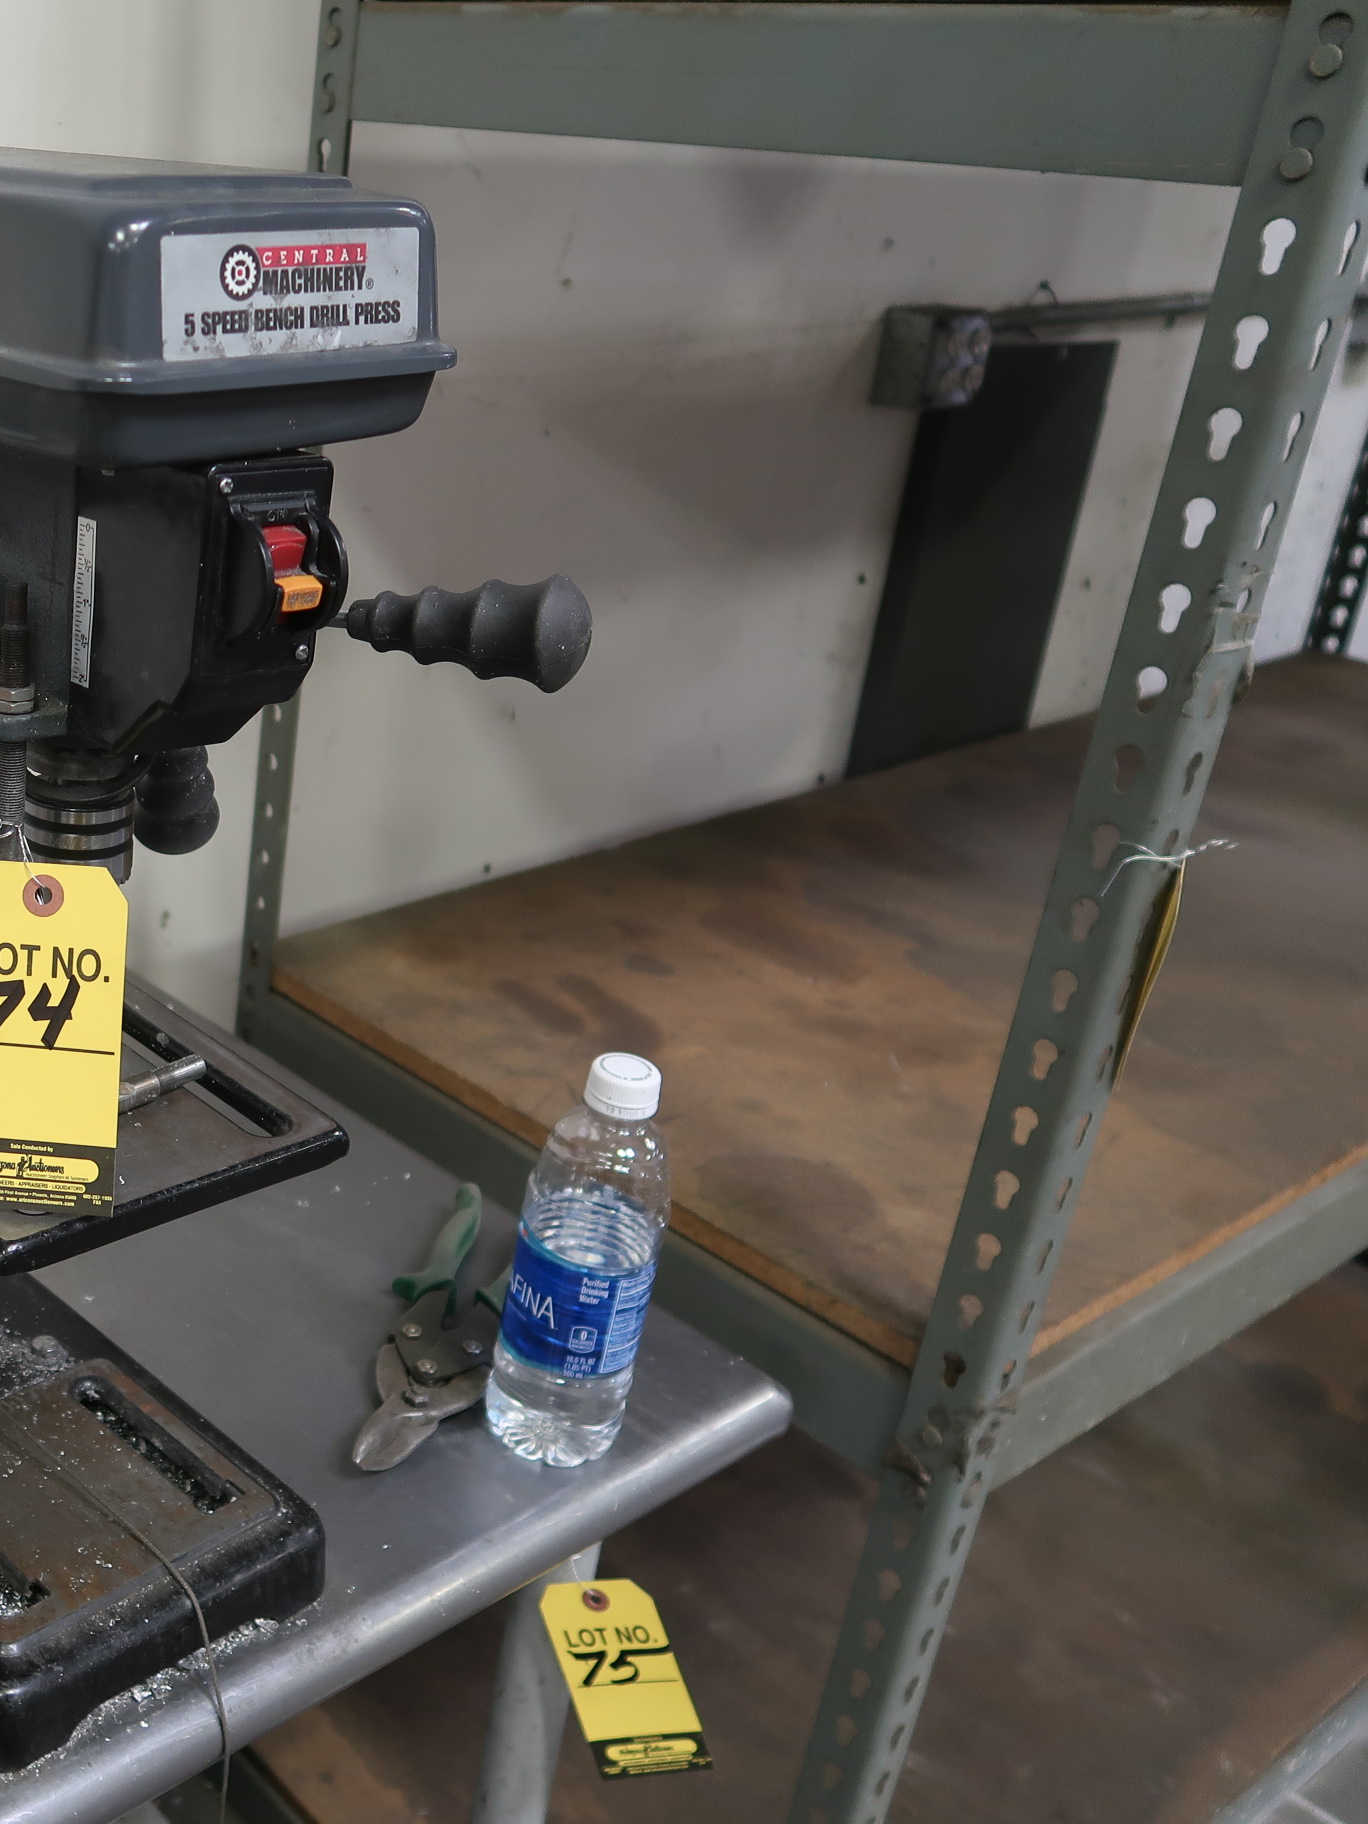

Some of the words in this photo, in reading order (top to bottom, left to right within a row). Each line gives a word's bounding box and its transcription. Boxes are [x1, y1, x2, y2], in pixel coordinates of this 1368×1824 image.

[262, 247, 364, 266] CENTRAL
[184, 313, 196, 337] 5
[200, 309, 250, 336] SPEED
[254, 305, 305, 332] BENCH
[309, 302, 350, 328] DRILL
[354, 300, 401, 325] PRESS
[51, 946, 109, 983] NO.
[22, 1144, 47, 1152] Conducted
[23, 1154, 65, 1175] Auctioneers
[18, 1181, 49, 1189] APPRAISERS
[52, 1184, 84, 1192] LIQUIDATORS
[582, 1277, 610, 1289] Purified
[579, 1295, 600, 1305] Water
[581, 1286, 610, 1299] Drinking
[580, 1331, 588, 1341] 0
[563, 1628, 607, 1648] LOT
[614, 1625, 659, 1645] NO.
[567, 1645, 668, 1687] 75
